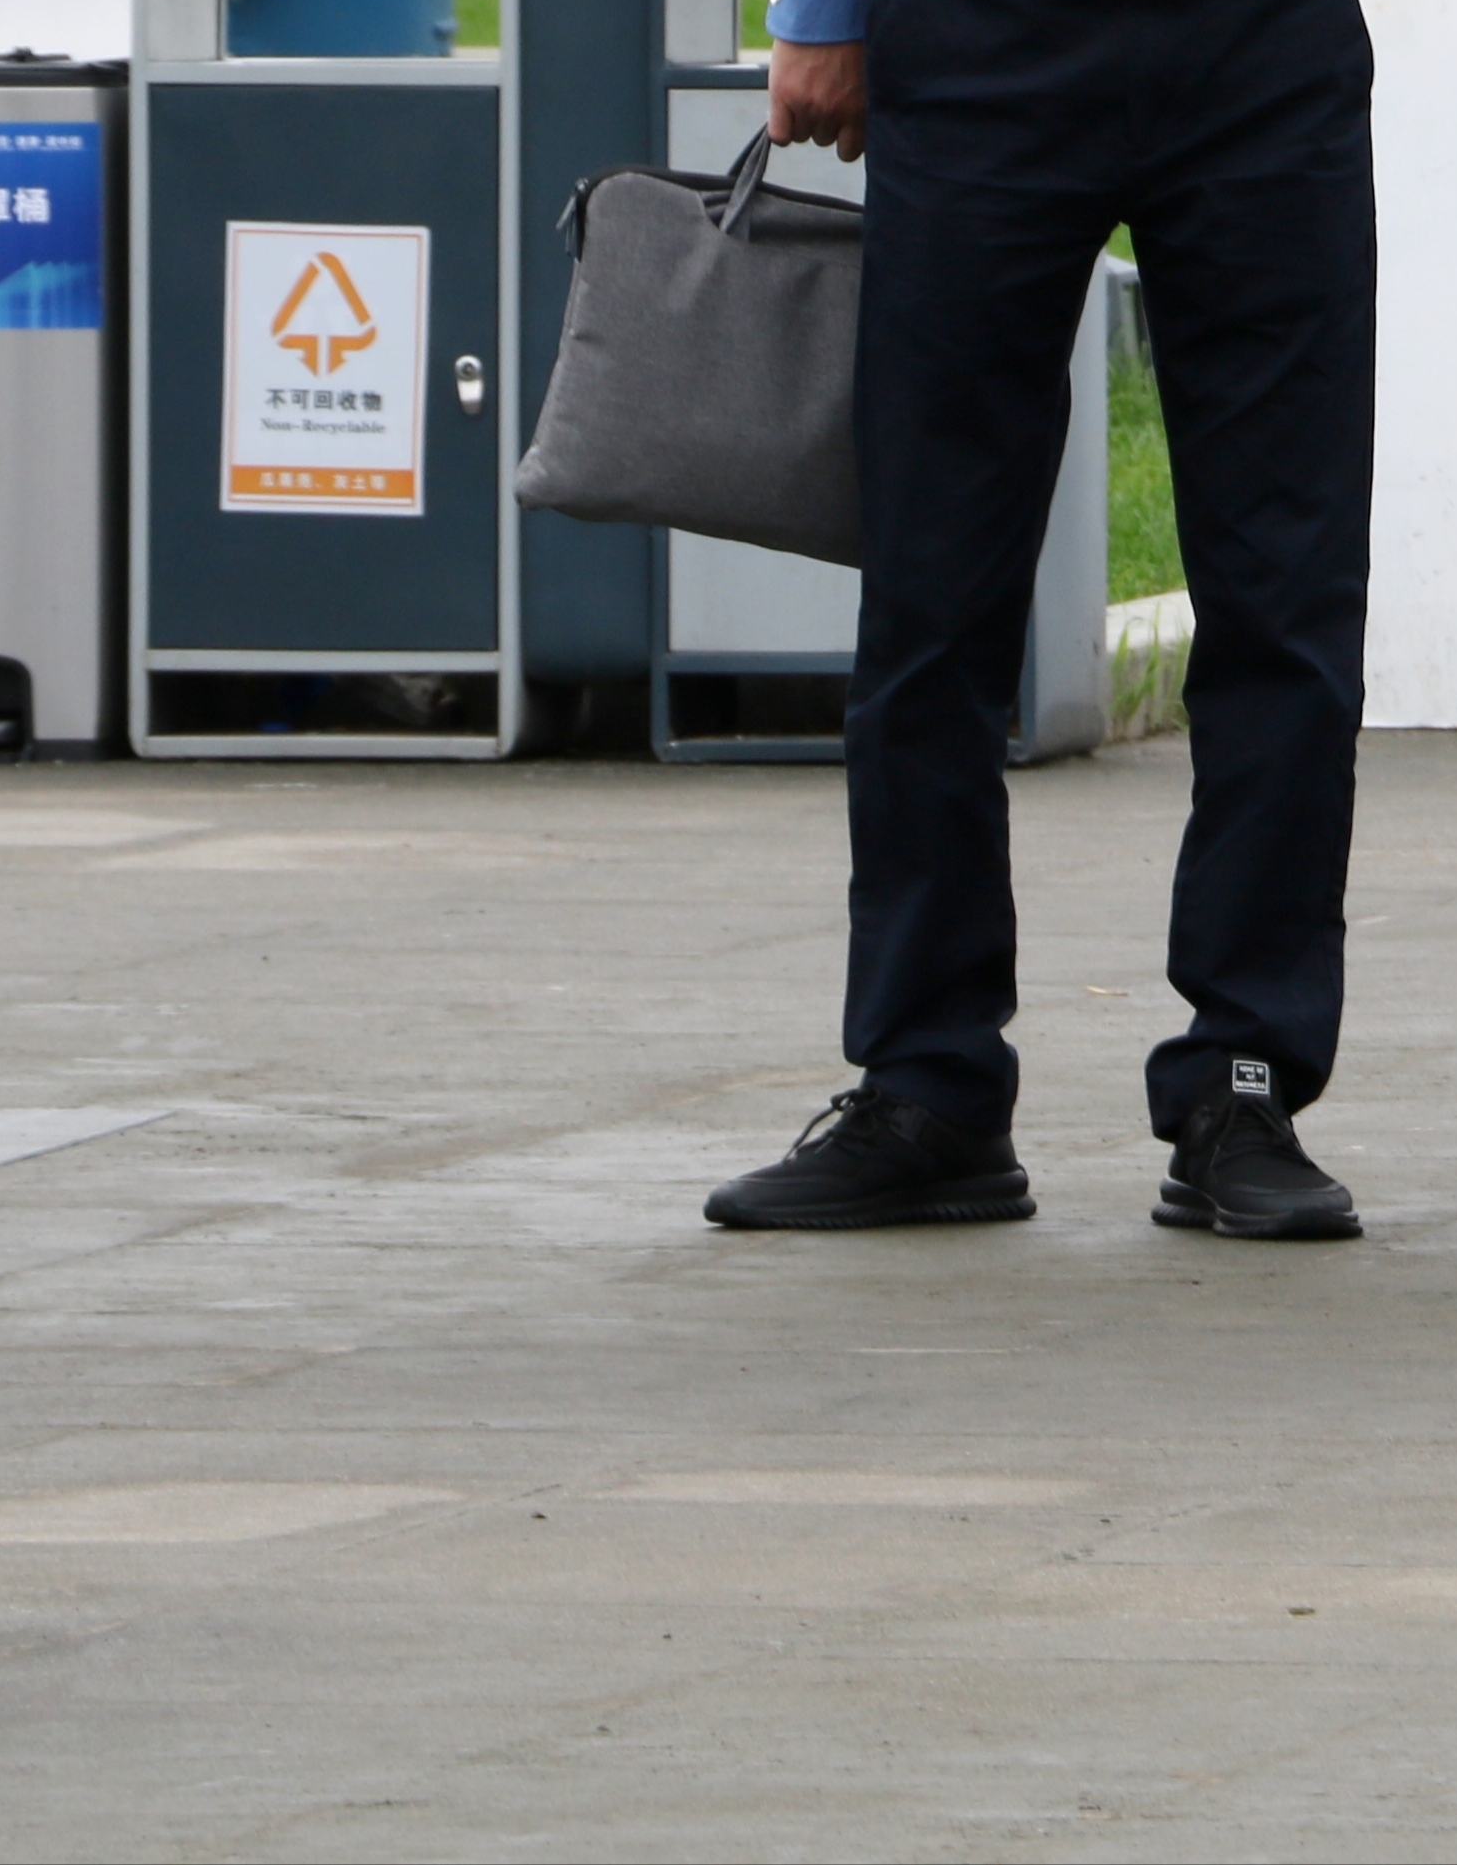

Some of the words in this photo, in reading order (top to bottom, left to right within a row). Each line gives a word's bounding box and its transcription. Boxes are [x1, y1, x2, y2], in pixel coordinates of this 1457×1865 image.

[264, 388, 383, 412] 不可回收物
